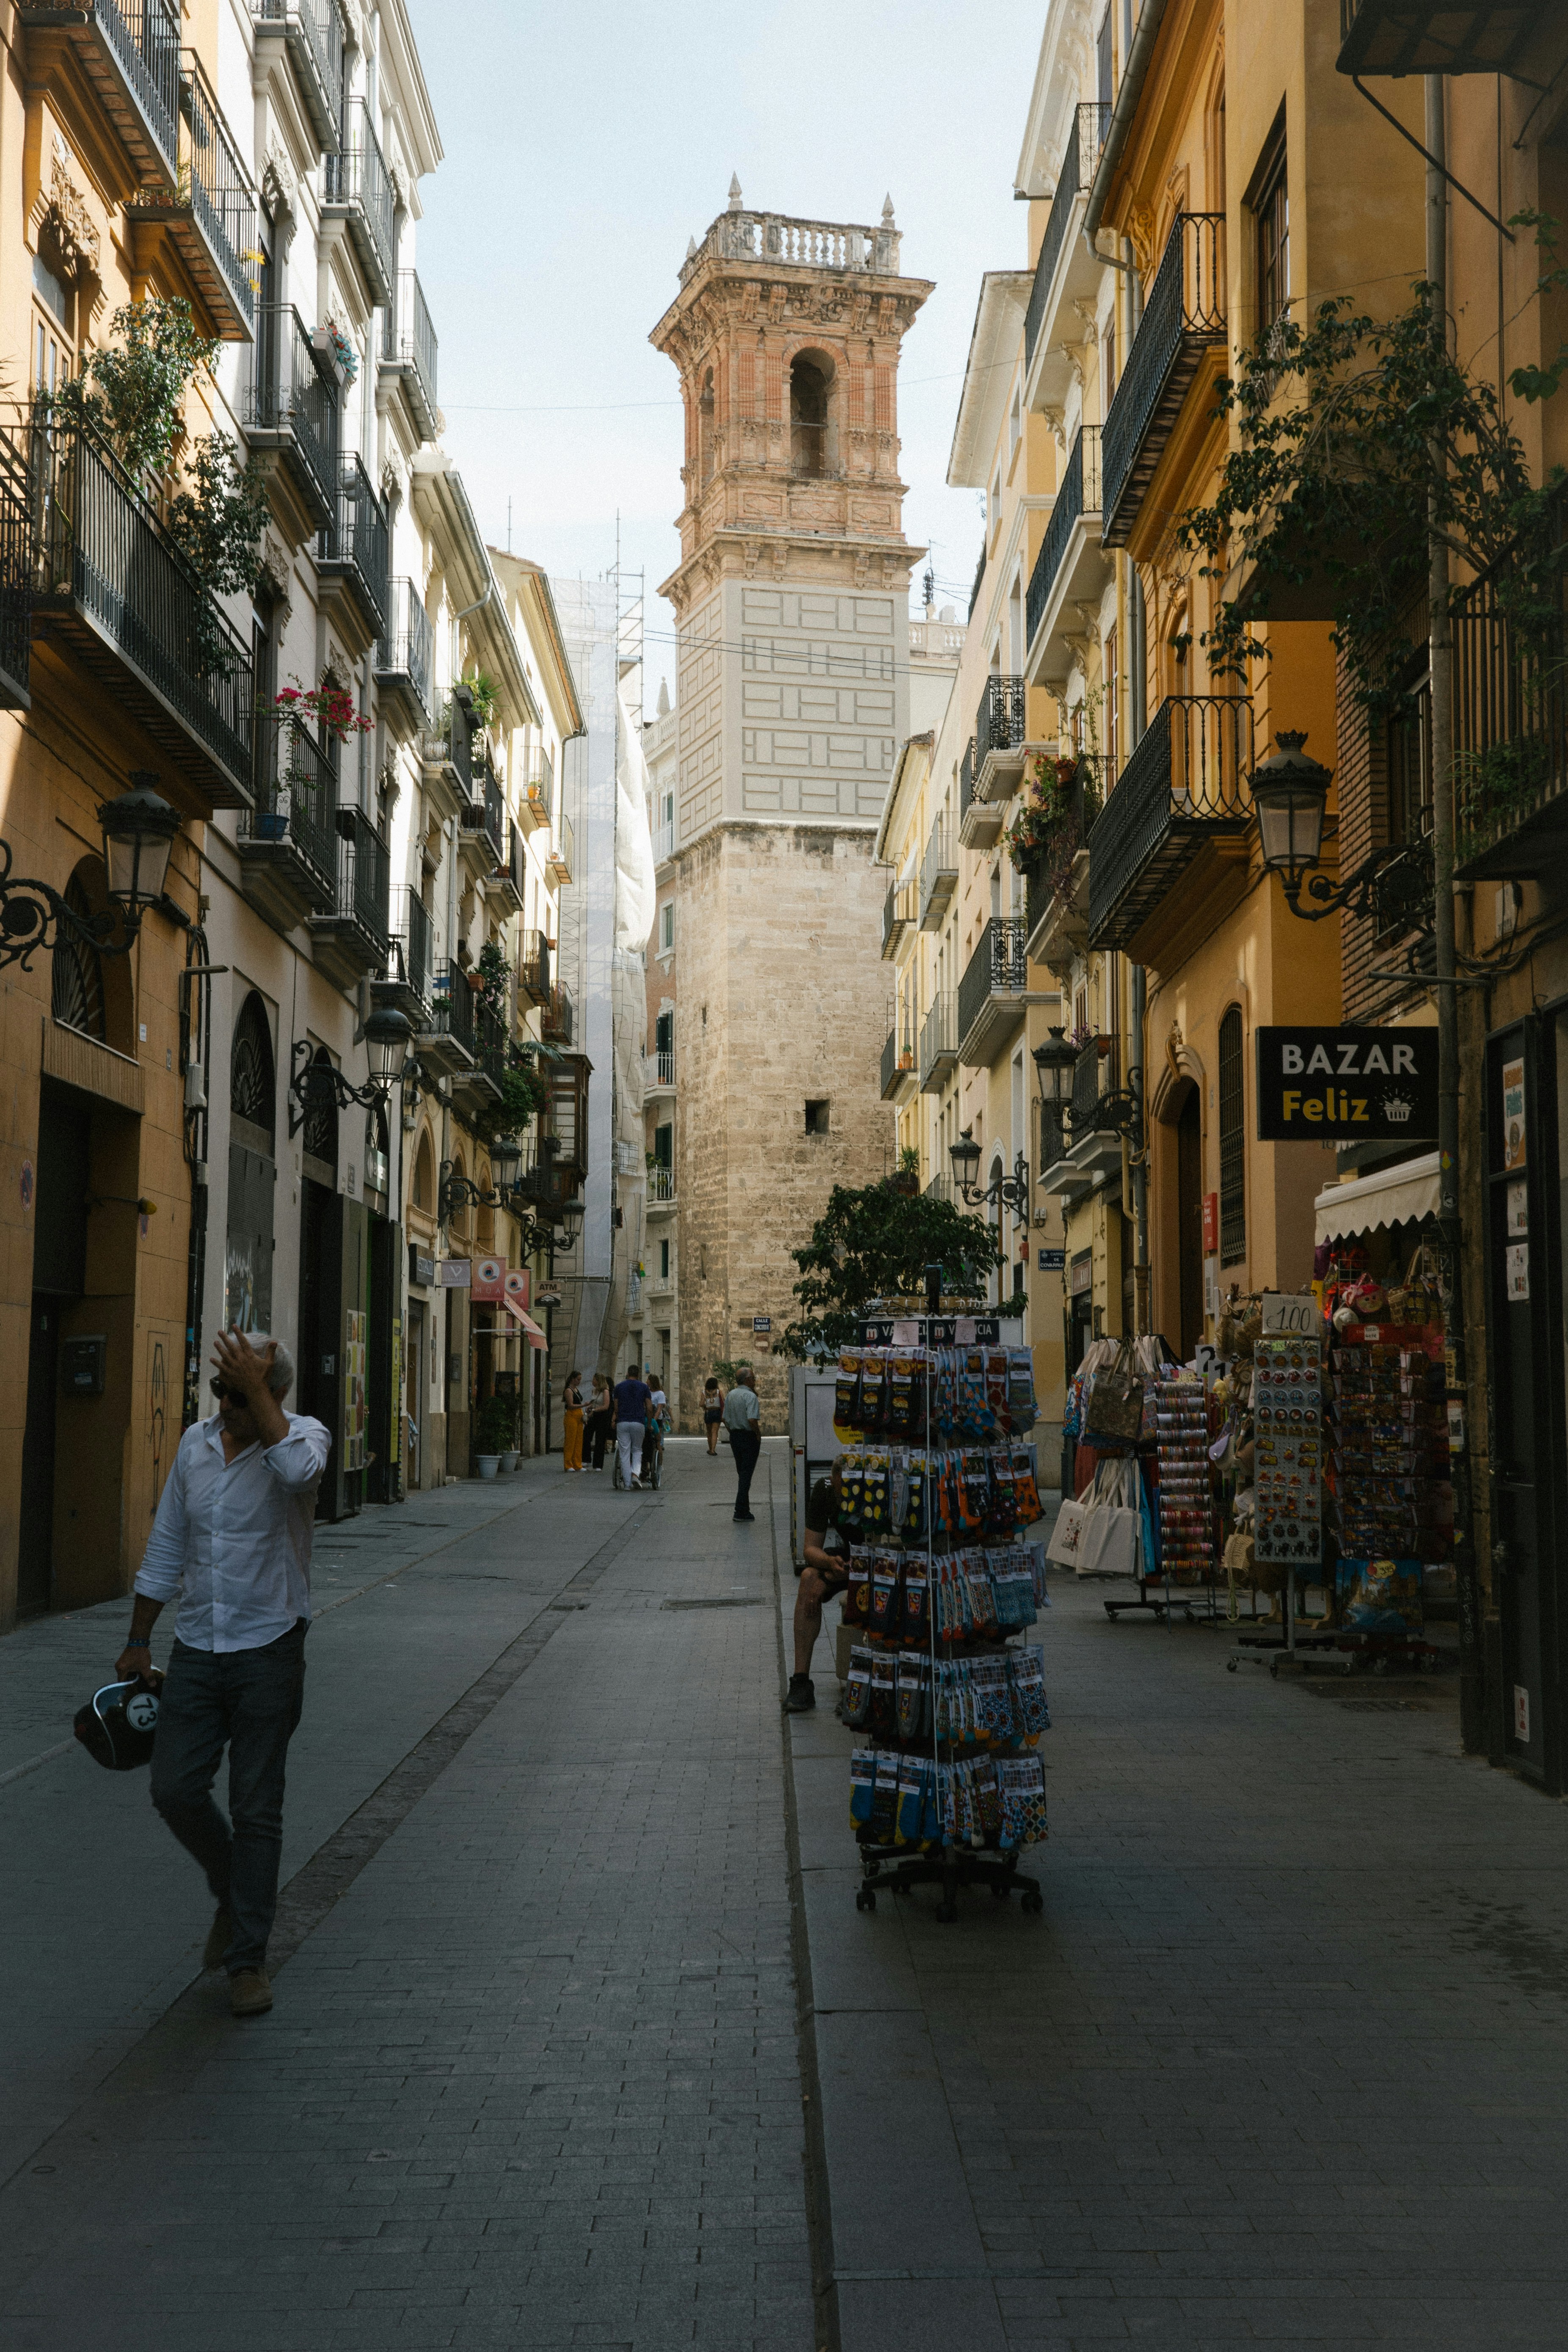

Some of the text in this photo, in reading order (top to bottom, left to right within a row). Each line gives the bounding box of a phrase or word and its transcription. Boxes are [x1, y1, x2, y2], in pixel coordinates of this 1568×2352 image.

[1282, 1044, 1419, 1075] BAZAR
[1283, 1087, 1370, 1121] Feliz
[132, 1697, 157, 1726] 73
